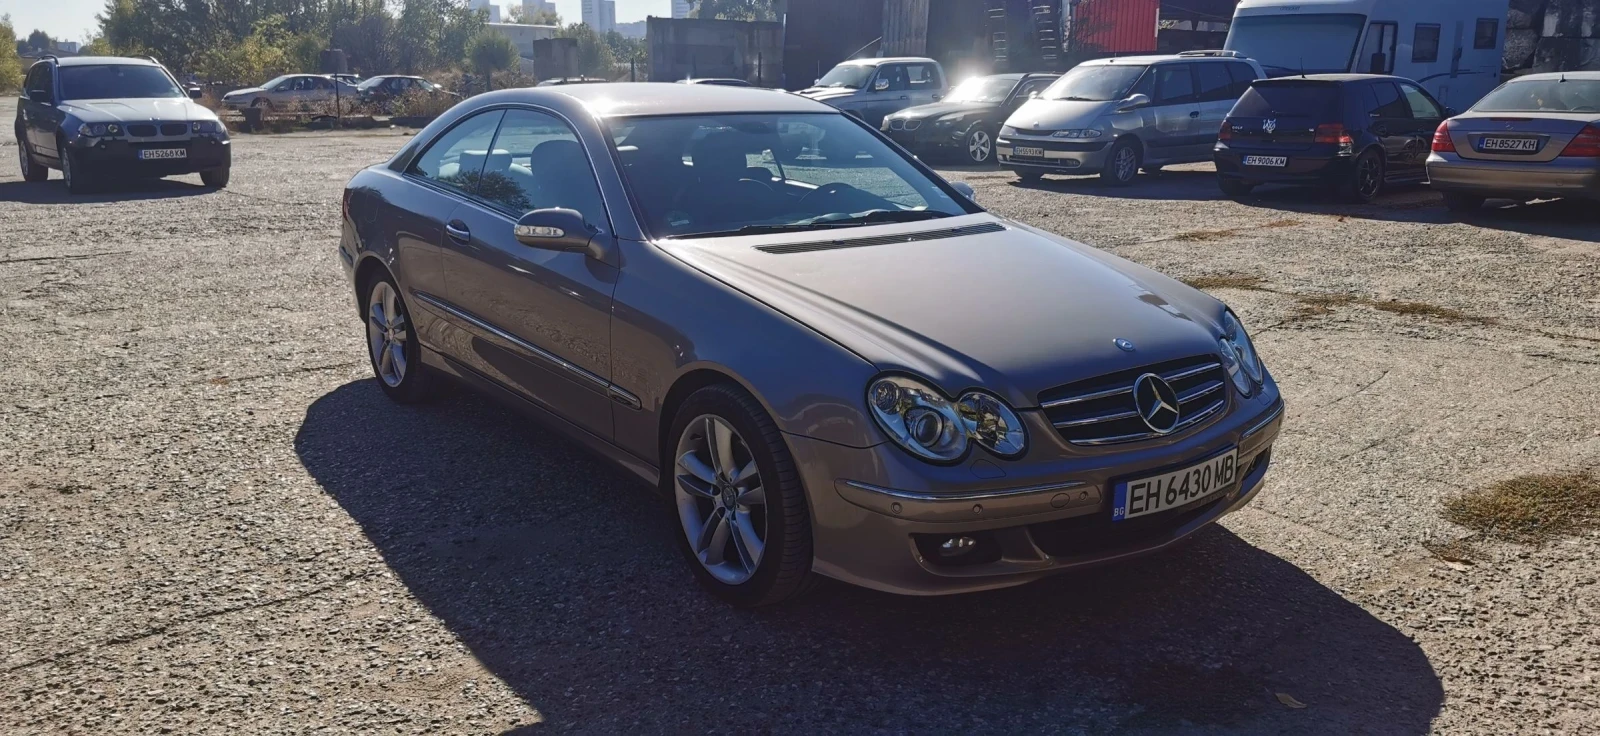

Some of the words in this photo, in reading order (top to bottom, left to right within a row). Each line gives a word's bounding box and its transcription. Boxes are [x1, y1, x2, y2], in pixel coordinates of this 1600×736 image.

[1485, 139, 1498, 148] EH
[1498, 139, 1521, 149] 8527
[1522, 140, 1536, 150] KH
[1129, 479, 1161, 515] EH
[1165, 464, 1211, 505] 6430
[1213, 454, 1234, 489] MB
[1113, 507, 1124, 517] BG
